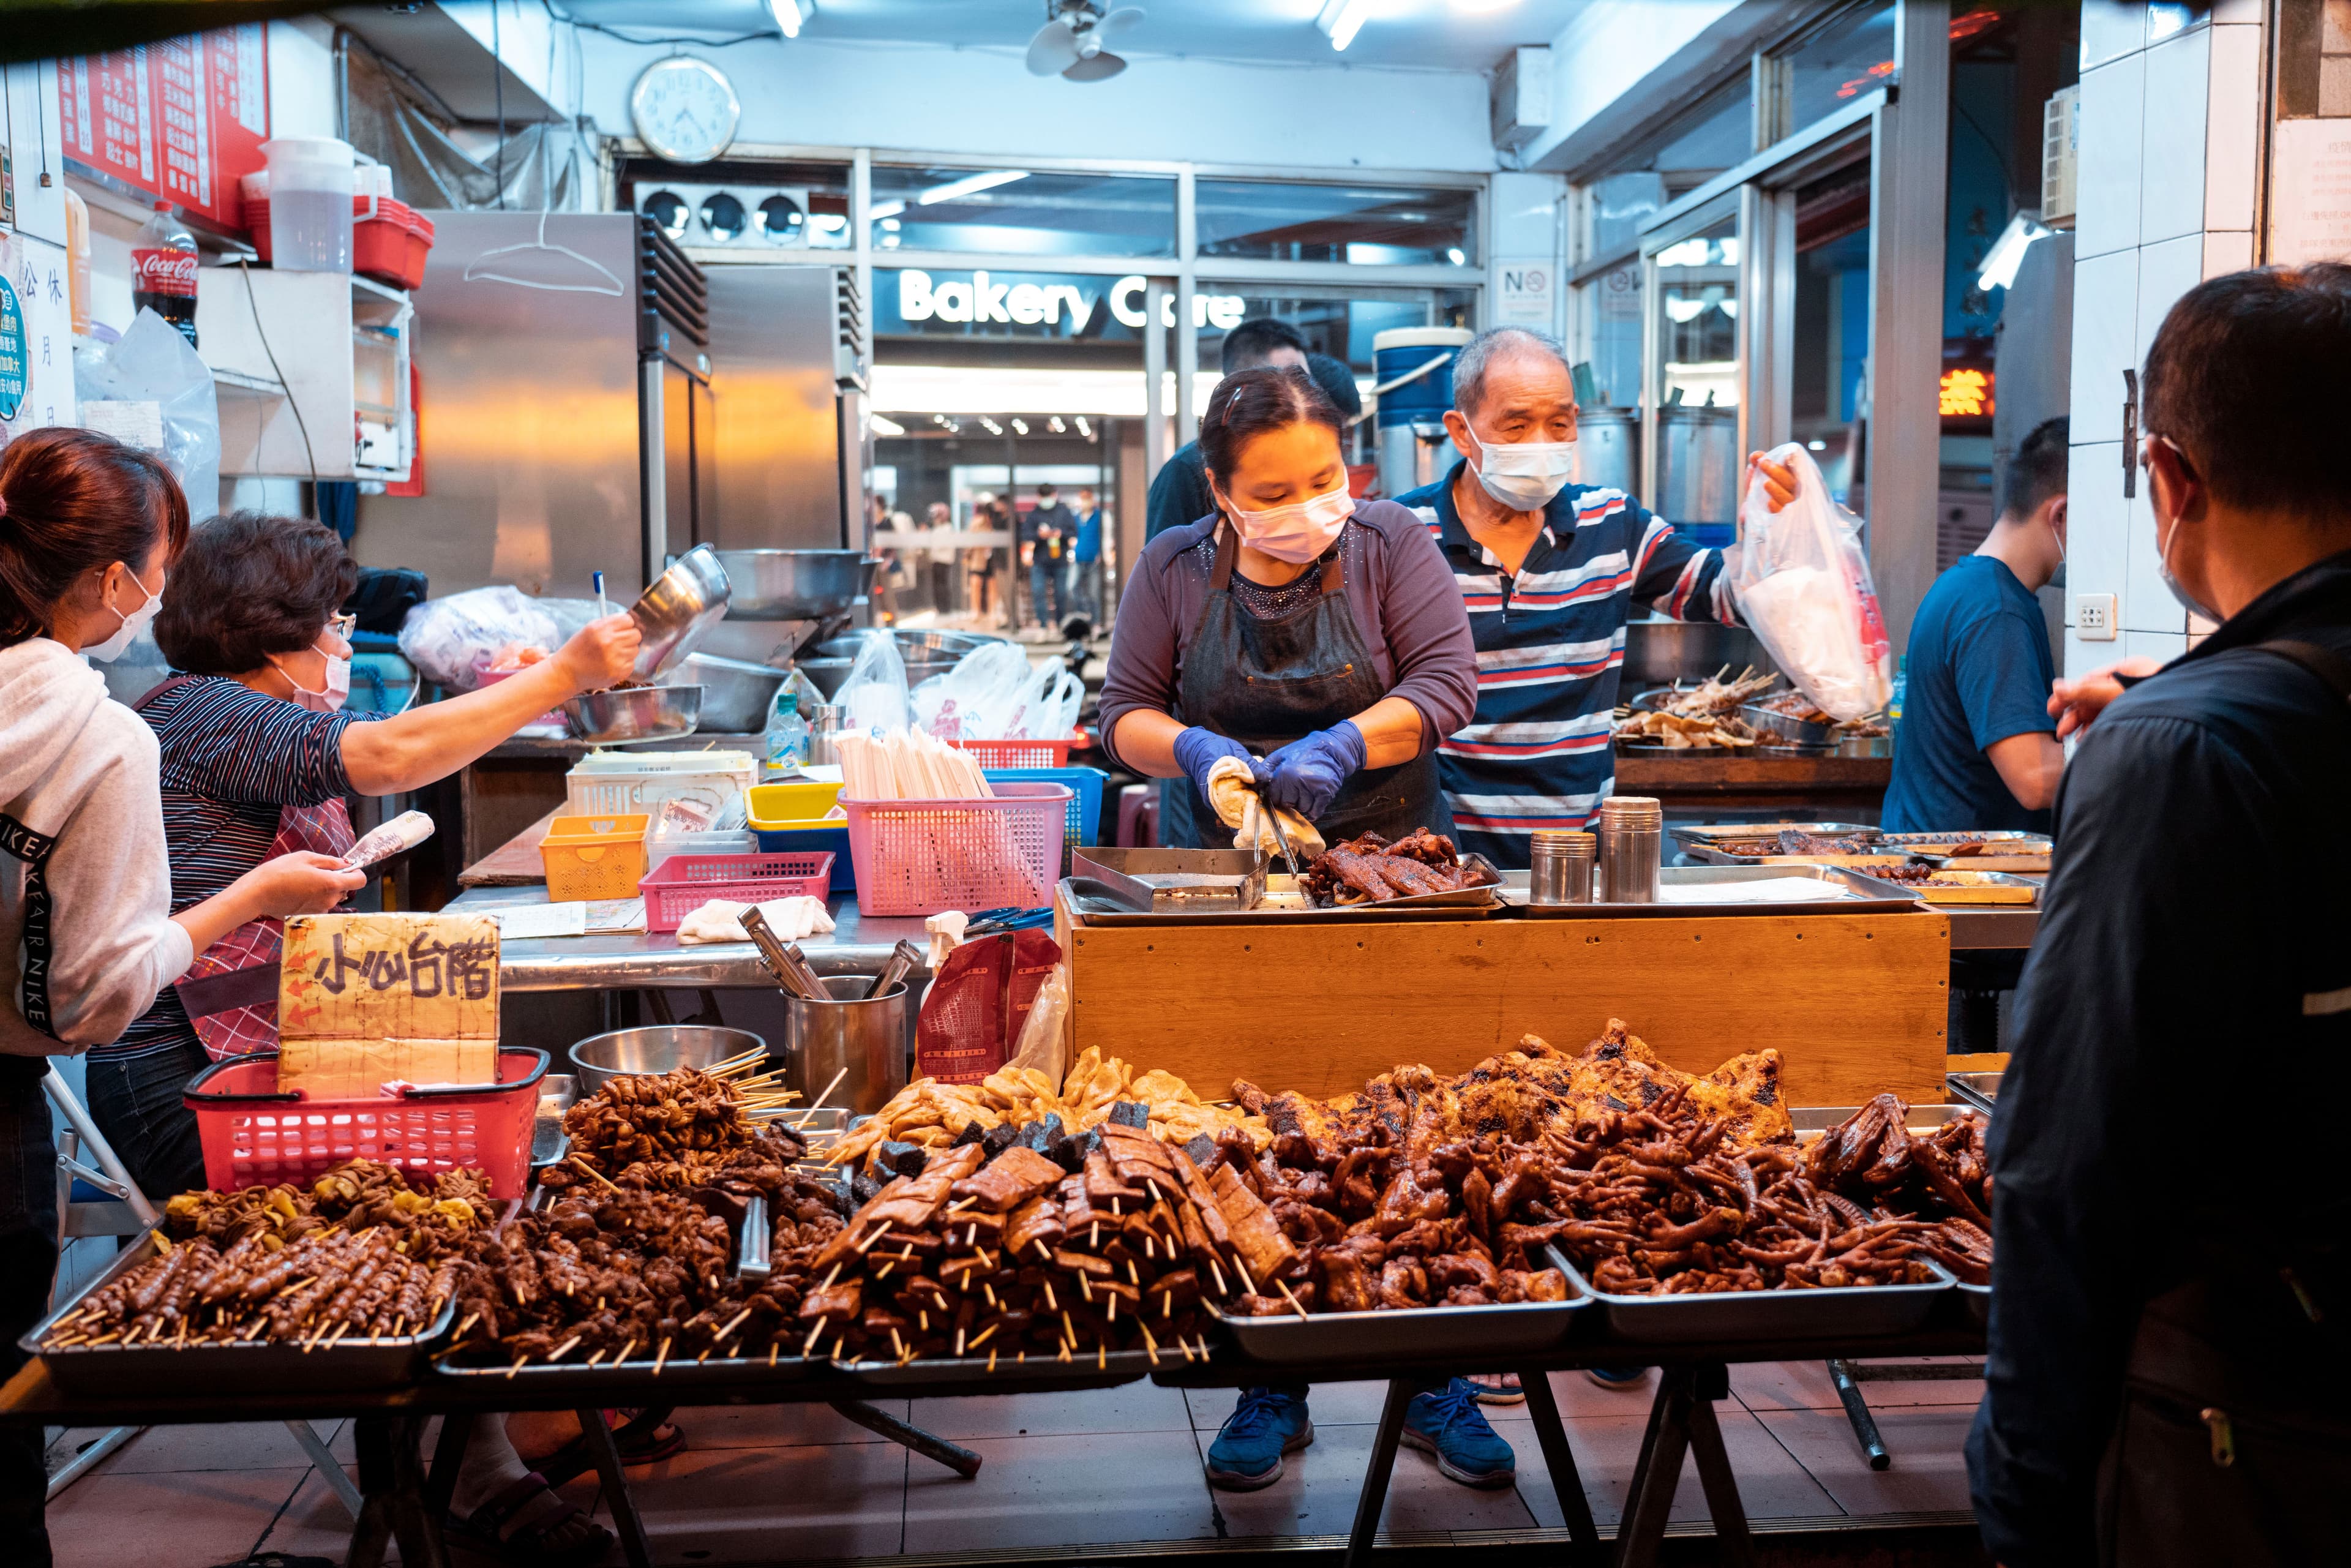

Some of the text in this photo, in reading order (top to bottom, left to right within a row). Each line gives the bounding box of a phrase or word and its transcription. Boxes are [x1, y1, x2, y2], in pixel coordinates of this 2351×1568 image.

[899, 269, 1093, 335] Bakery
[1, 314, 17, 332] 堡肉
[42, 335, 51, 367] 月
[0, 378, 22, 396] 安心食用
[0, 819, 40, 857] IKE
[314, 931, 497, 1000] 小心台階
[26, 957, 46, 1022] NIKE
